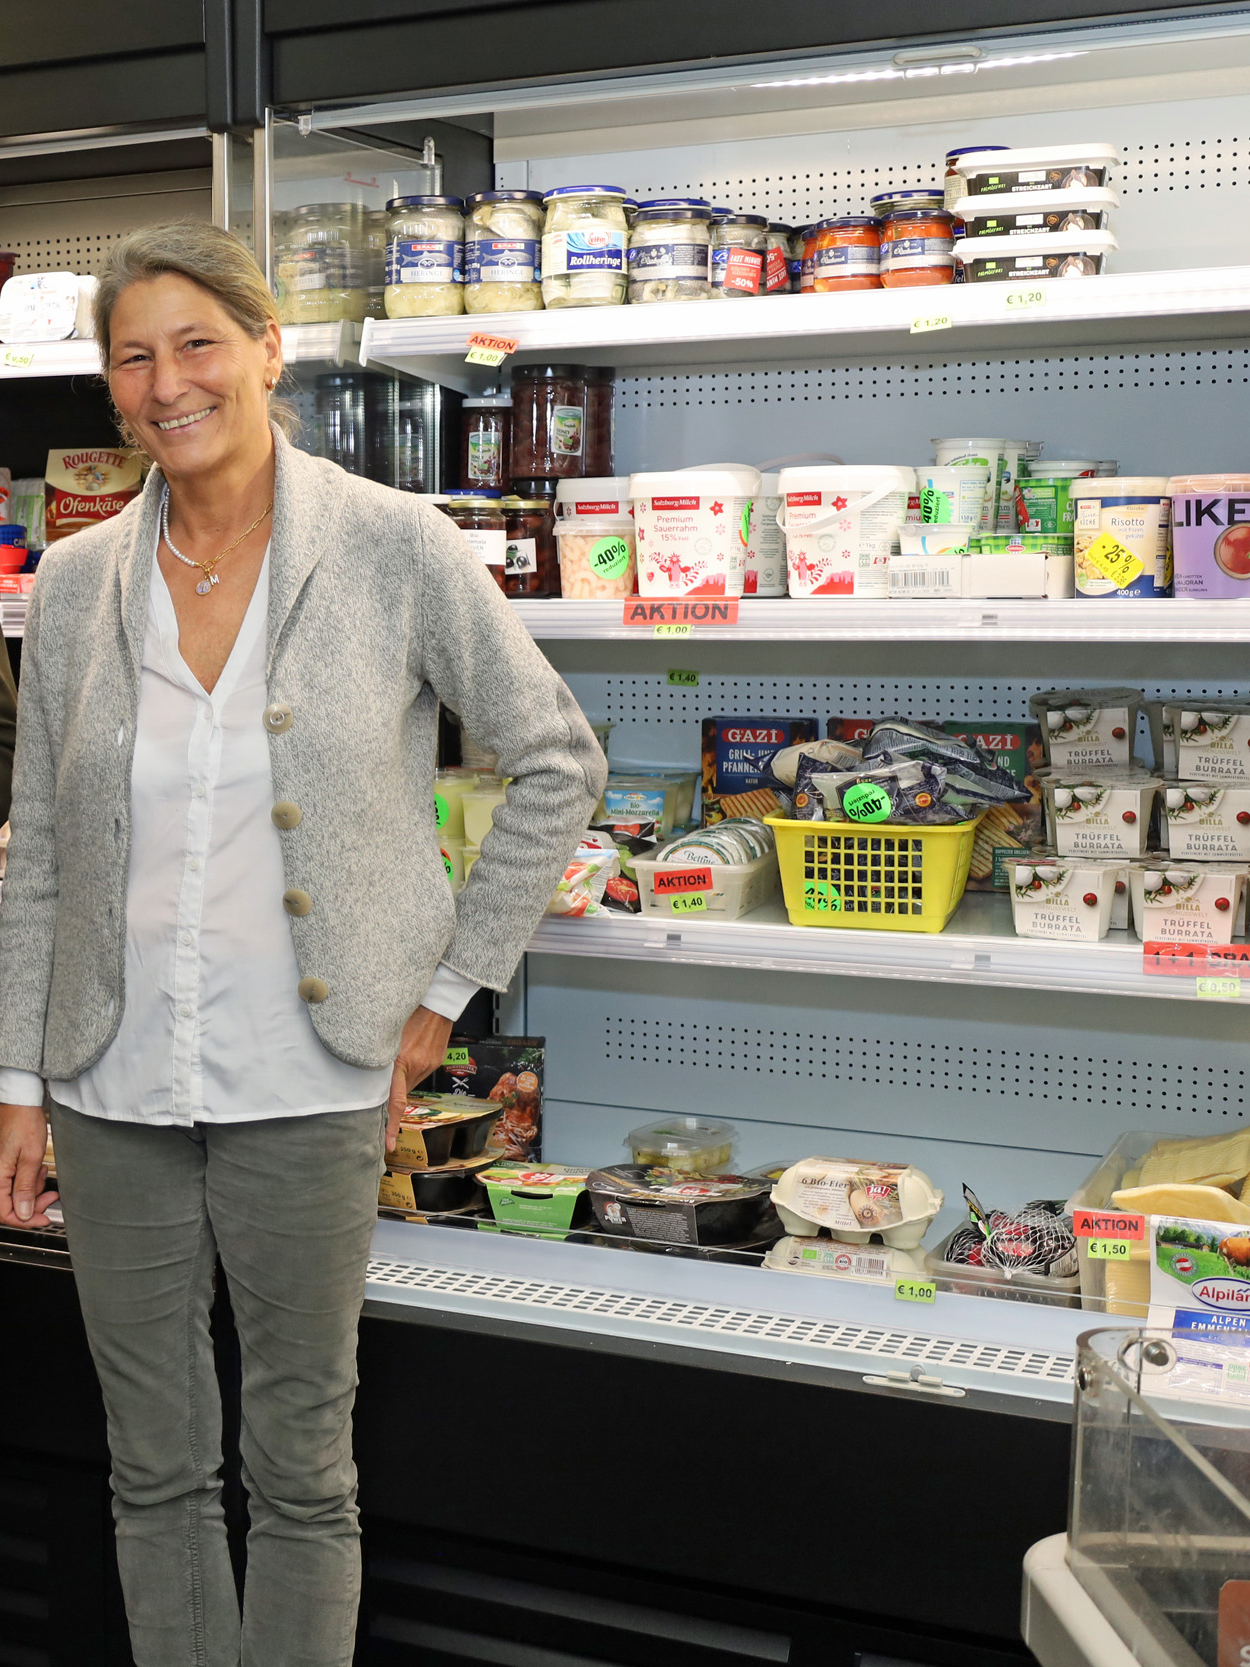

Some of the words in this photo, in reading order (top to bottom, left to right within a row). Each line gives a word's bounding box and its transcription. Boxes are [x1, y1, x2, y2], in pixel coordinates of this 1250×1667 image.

[1012, 183, 1052, 192] STREICHZART
[1009, 226, 1050, 235] STREICHZART
[570, 255, 620, 267] Rollheringe
[410, 269, 444, 278] HERINGE
[491, 268, 524, 277] HERINGE
[1009, 269, 1050, 277] STREICHZART
[731, 279, 754, 289] -50%
[1007, 295, 1014, 304] €
[1018, 292, 1042, 304] 1,20
[914, 320, 920, 328] €
[924, 317, 948, 327] 1,20
[469, 335, 515, 352] AKTION
[478, 352, 498, 363] 1,00
[62, 451, 127, 470] ROUGETTE
[60, 497, 125, 516] Ofenkäse
[657, 515, 693, 523] Premium
[1111, 517, 1145, 527] Risotto
[654, 524, 698, 533] Sauerrahm
[661, 533, 678, 541] 15%
[594, 541, 627, 568] -40%
[603, 555, 626, 574] reduziert
[630, 602, 729, 621] AKTION
[656, 626, 663, 634] €
[666, 625, 688, 635] 1,00
[669, 673, 675, 681] €
[676, 673, 697, 683] 1,40
[1210, 742, 1234, 750] BILLA
[1068, 749, 1112, 758] TRÜFFEL
[1067, 757, 1114, 765] BURRATA
[1198, 756, 1244, 766] TRÜFFEL
[1195, 765, 1245, 775] BURRATA
[851, 788, 876, 807] reduziert
[611, 808, 660, 816] Mini-Mozzarella
[849, 795, 886, 820] -40%
[1075, 832, 1121, 841] TRÜFFEL
[1188, 833, 1236, 842] TRÜFFEL
[1073, 842, 1123, 850] BURRATA
[1186, 843, 1238, 852] BURRATA
[658, 874, 708, 888] AKTION
[673, 899, 679, 908] €
[681, 897, 703, 908] 1,40
[1046, 898, 1070, 906] BILLA
[1175, 903, 1201, 911] BILLA
[1034, 912, 1081, 924] TRÜFFEL
[1163, 917, 1212, 929] TRÜFFEL
[1032, 921, 1082, 933] BURRATA
[1161, 928, 1214, 939] BURRATA
[1152, 951, 1161, 966] 1
[1186, 951, 1194, 966] 1
[1198, 983, 1206, 992] €
[1210, 982, 1237, 993] 0,50
[447, 1052, 467, 1061] 4,20
[801, 1176, 808, 1184] 6
[810, 1177, 850, 1189] Bio-Eier
[869, 1185, 887, 1195] ja!
[1080, 1218, 1139, 1232] AKTION
[1090, 1243, 1097, 1253] €
[1101, 1243, 1127, 1256] 1,50
[897, 1285, 905, 1295] €
[908, 1285, 932, 1299] 1,00
[1211, 1315, 1247, 1327] ALPEN
